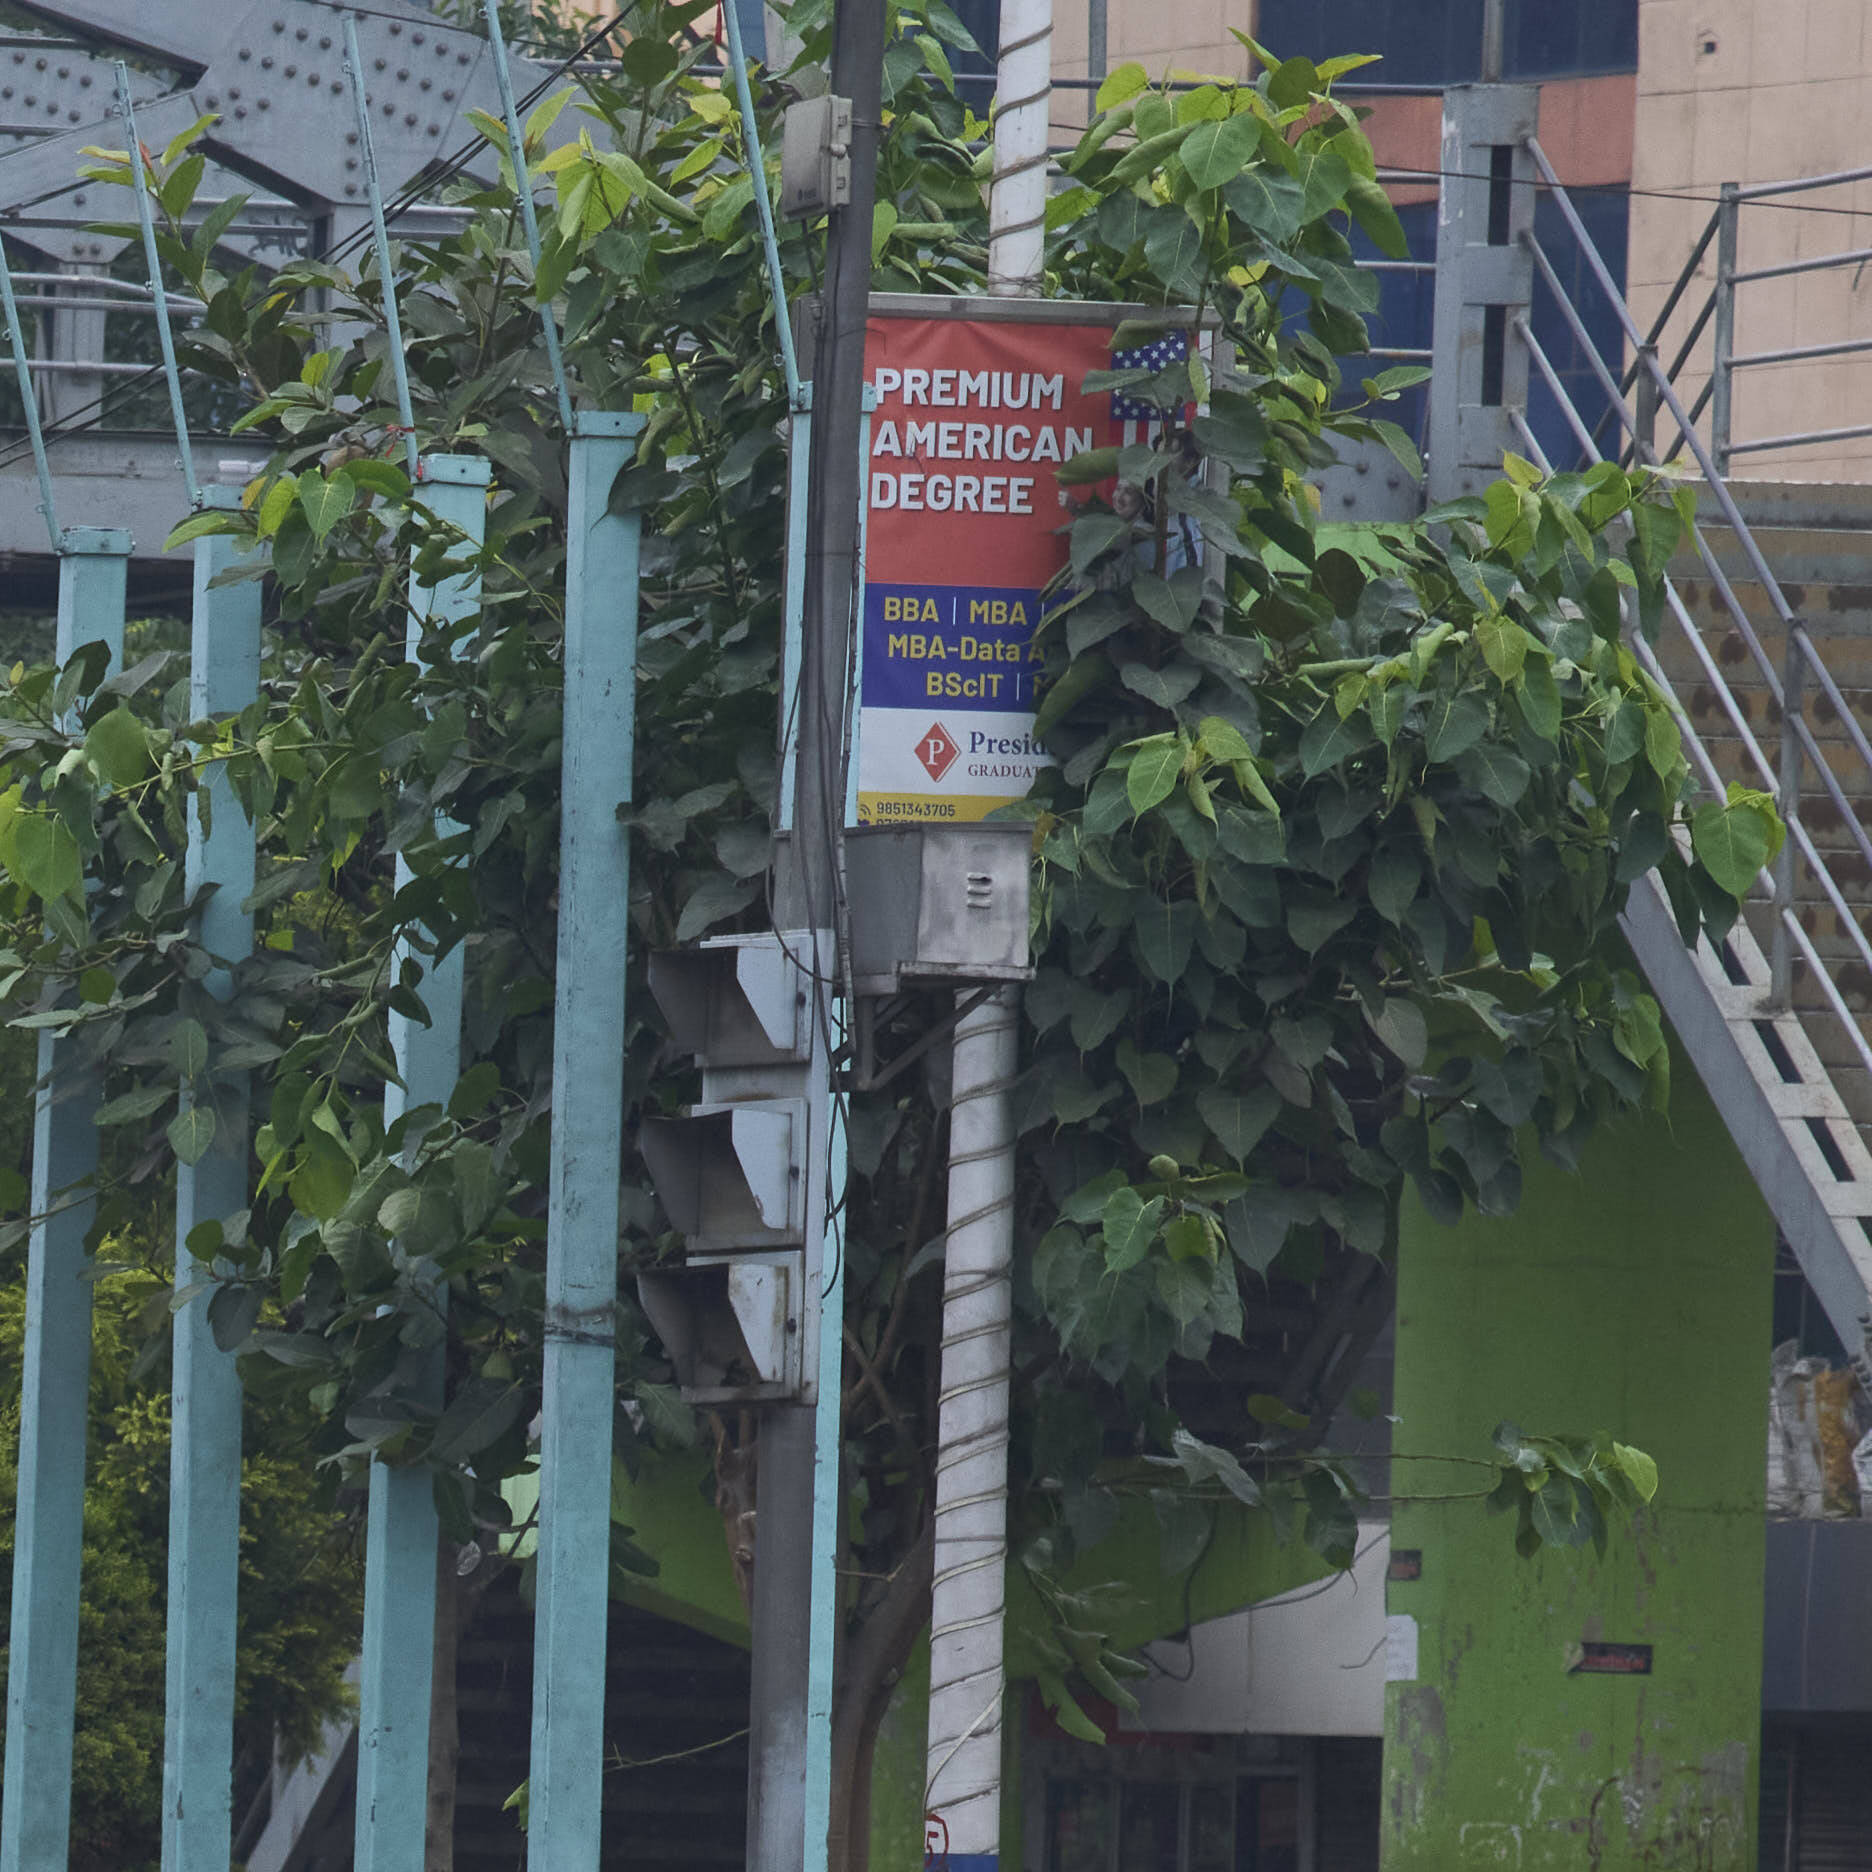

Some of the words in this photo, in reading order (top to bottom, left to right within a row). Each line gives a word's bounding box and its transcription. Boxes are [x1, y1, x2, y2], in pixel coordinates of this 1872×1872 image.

[874, 367, 1064, 410] PREMIUM
[872, 420, 1093, 463] AMERICAN
[871, 472, 1035, 514] DEGREE
[884, 597, 940, 622] BBA
[969, 599, 1028, 626] MBA
[887, 634, 1021, 662] MBA-Data
[926, 672, 1004, 698] BScIT
[876, 801, 957, 817] 9851343705
